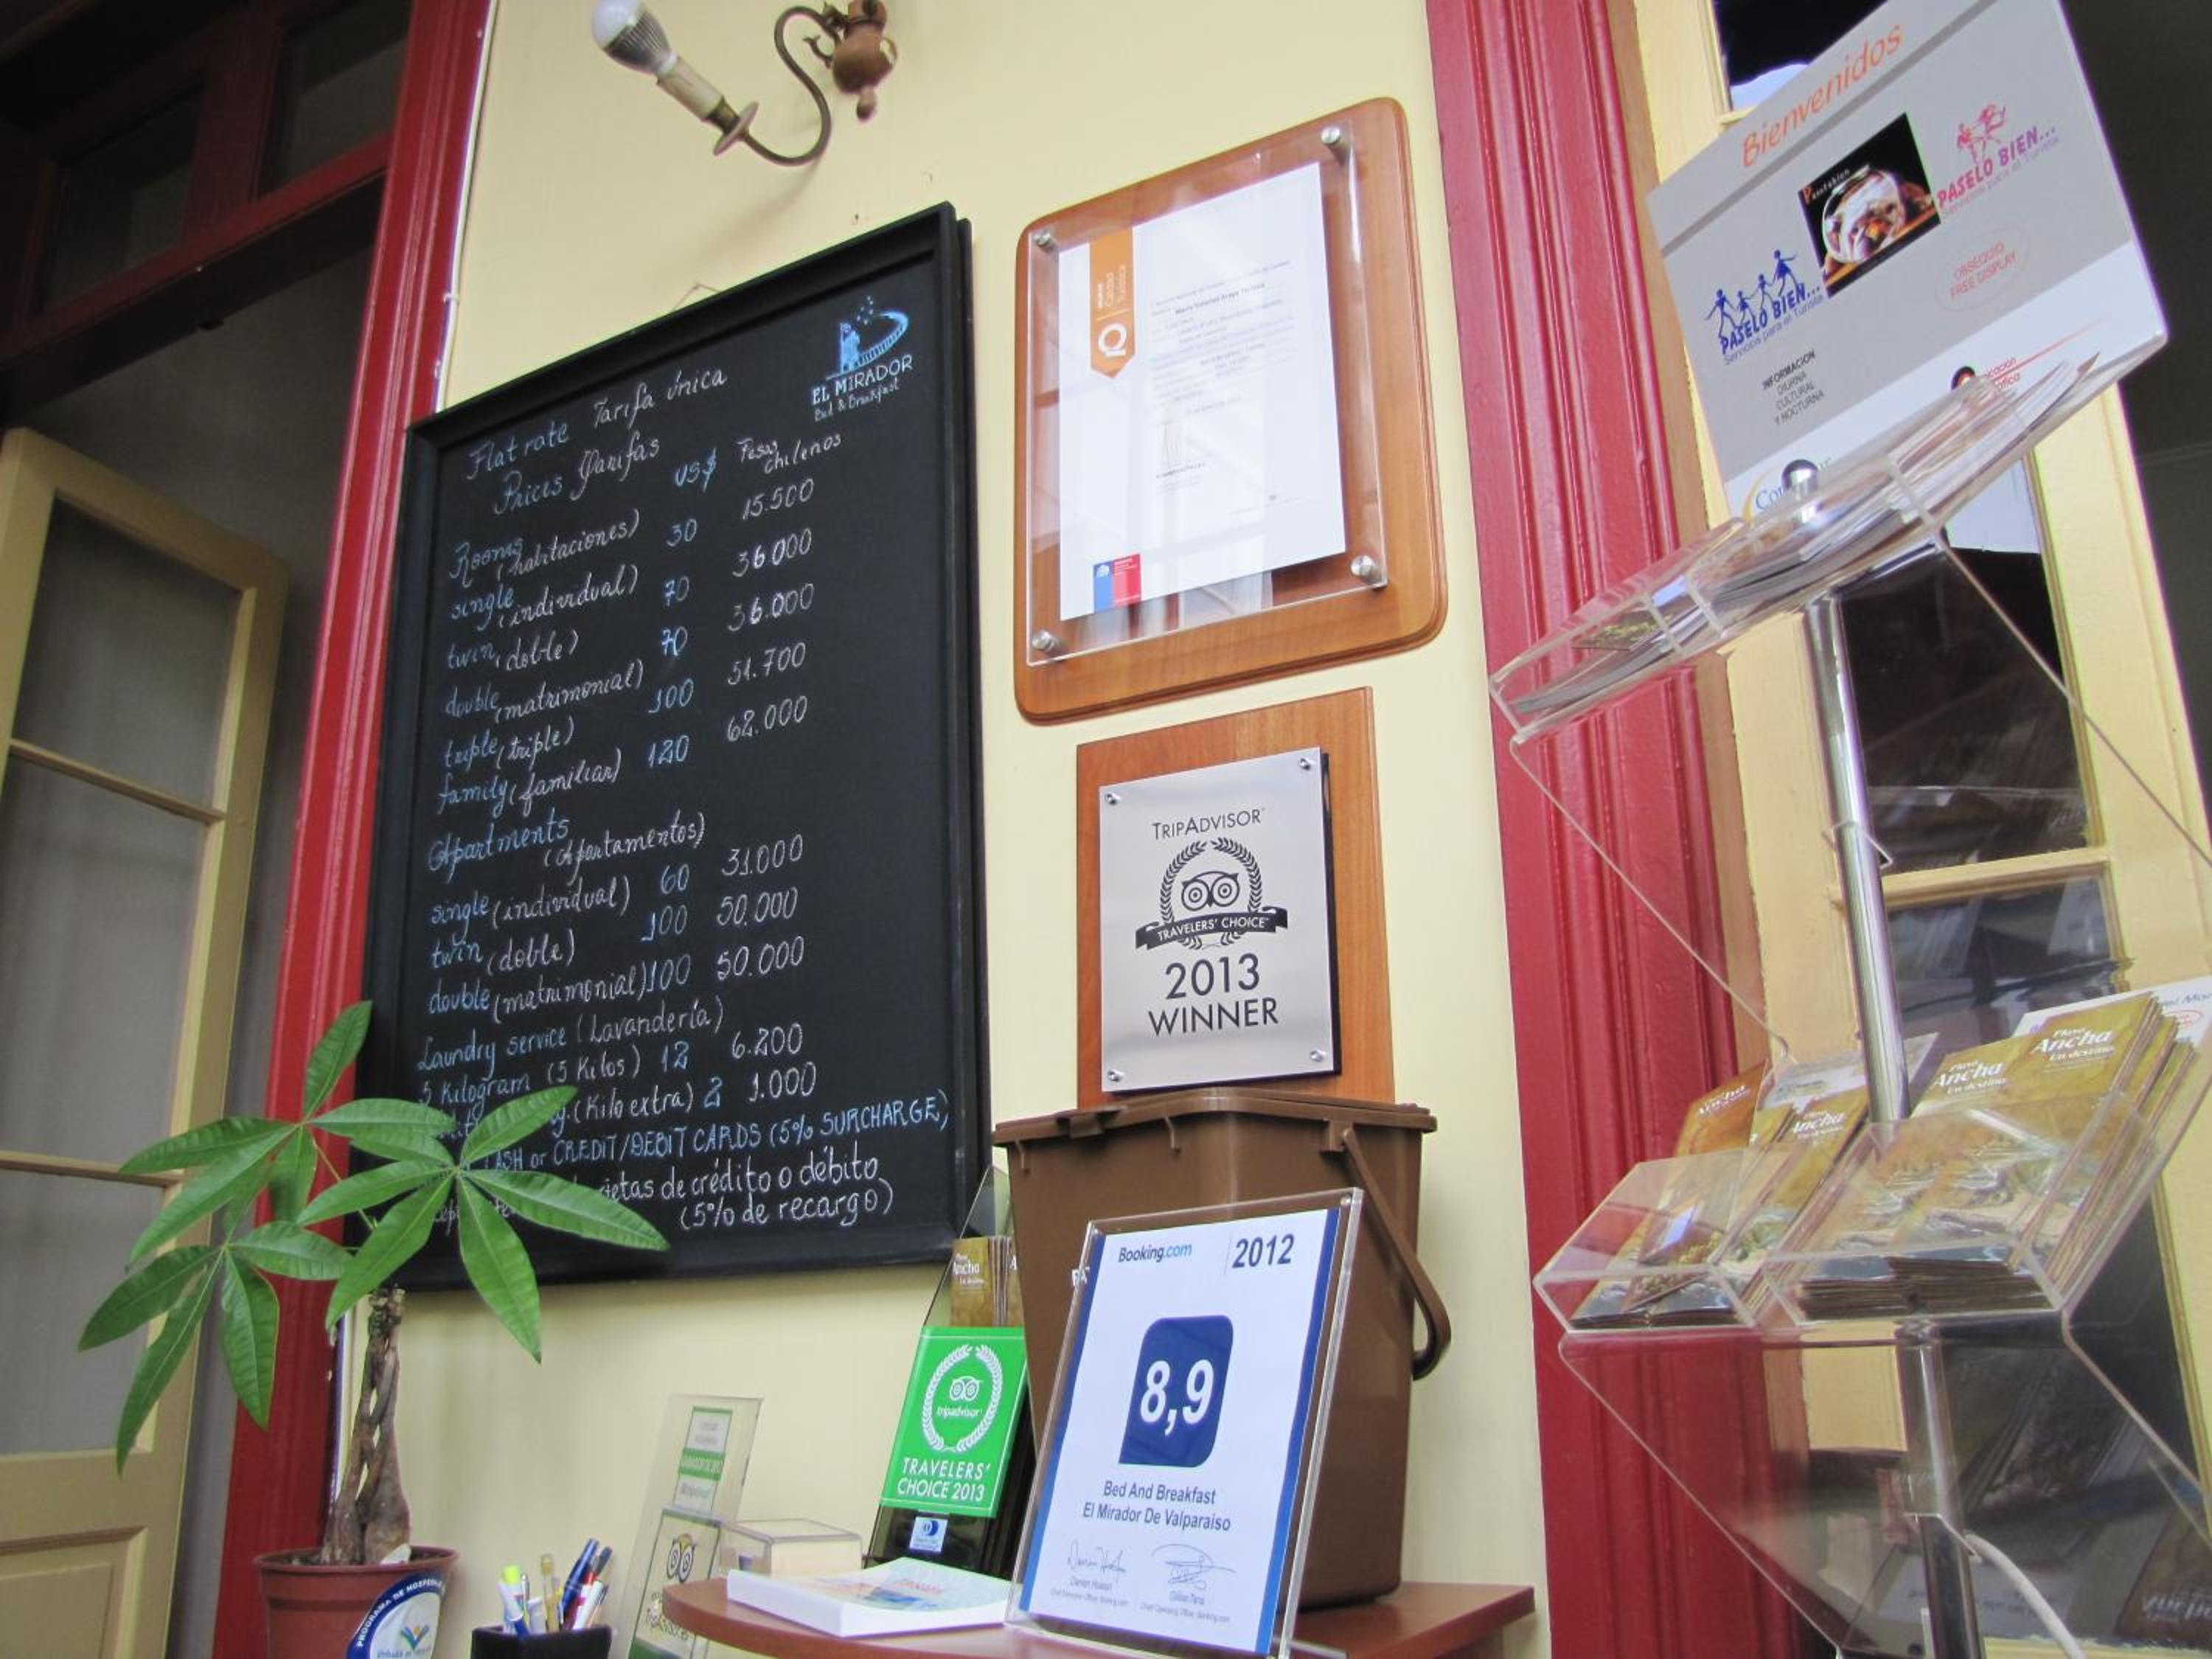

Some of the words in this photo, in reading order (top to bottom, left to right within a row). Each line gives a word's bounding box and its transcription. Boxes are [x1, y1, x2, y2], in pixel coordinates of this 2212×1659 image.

[1742, 24, 1902, 167] Bienvenidos
[1936, 158, 1993, 210] PASELO
[1998, 126, 2056, 167] BIEN...
[1720, 308, 1768, 355] PASELO
[1772, 282, 1820, 319] BIEN...
[812, 386, 830, 406] EL
[835, 354, 914, 396] MIRADOR
[467, 437, 518, 481] Flat
[524, 422, 570, 456] rate
[594, 381, 656, 429] Tarifa
[737, 437, 778, 464] Pesos
[765, 434, 841, 474] chilenos
[494, 470, 563, 515] Prices
[674, 448, 717, 492] US$
[666, 518, 698, 547] 30
[742, 479, 814, 521] 15.500
[495, 507, 640, 582] (habitaciones)
[451, 586, 515, 631] single
[498, 564, 639, 628] (individual)
[664, 576, 689, 607] 70
[445, 682, 501, 718] double
[495, 658, 644, 723] (matrimonial)
[444, 727, 498, 773] triple
[496, 714, 574, 771] (triple)
[437, 772, 508, 819] family
[509, 746, 622, 818] (familiar)
[660, 863, 690, 895] 60
[720, 833, 804, 877] 31.000
[431, 889, 490, 946] single
[492, 874, 631, 930] (individual)
[717, 886, 799, 928] 50.000
[1221, 916, 1266, 930] CHOICE
[431, 939, 484, 970] twin
[487, 927, 575, 976] (doble)
[1165, 953, 1260, 1000] 2013
[429, 978, 490, 1015] double
[494, 961, 647, 1025] (matrimonial)
[717, 935, 804, 982] 50.000
[1148, 996, 1279, 1037] WINNER
[2029, 1031, 2113, 1054] Ancha
[417, 1028, 497, 1082] Laundry
[507, 1026, 568, 1057] service
[441, 1071, 531, 1124] Kilogram
[548, 1065, 568, 1087] (5
[577, 1043, 642, 1080] Kilos)
[660, 1040, 692, 1074] 12
[731, 1022, 804, 1060] 6.200
[1935, 1062, 2005, 1087] Ancha
[630, 1082, 695, 1118] extra)
[702, 1075, 724, 1110] 2
[748, 1061, 817, 1104] 1.000
[484, 1147, 523, 1172] ASH
[530, 1152, 548, 1169] or
[692, 1121, 762, 1152] CARDS
[768, 1114, 814, 1147] (5%
[661, 1166, 686, 1200] de
[691, 1155, 771, 1194] crédito
[778, 1166, 793, 1189] o
[800, 1140, 880, 1185] débito
[680, 1197, 735, 1231] (5%
[742, 1192, 769, 1225] de
[779, 1178, 894, 1226] recargo)
[1117, 1242, 1193, 1263] Booking.com
[1231, 1233, 1295, 1269] 2012
[1139, 1359, 1215, 1436] 8,9
[897, 1477, 949, 1499] CHOICE
[951, 1481, 985, 1503] 2013
[1082, 1501, 1097, 1519] El
[1097, 1503, 1142, 1523] Mirador
[1143, 1507, 1162, 1525] De
[1165, 1509, 1231, 1532] Valparaiso
[1103, 1480, 1127, 1498] Bed
[1128, 1481, 1154, 1500] And
[1155, 1484, 1217, 1506] Breakfast
[392, 1588, 405, 1601] DE
